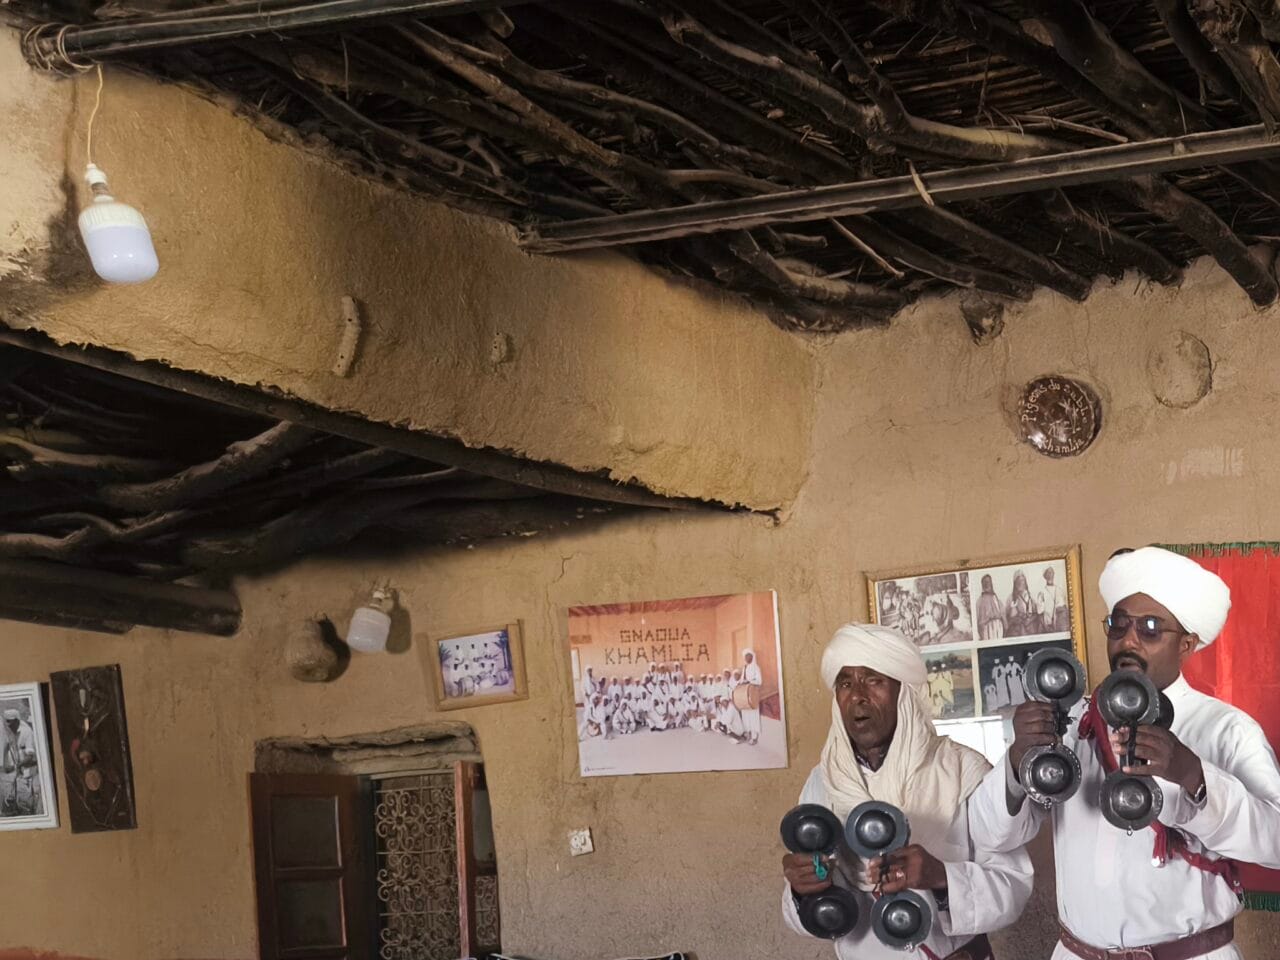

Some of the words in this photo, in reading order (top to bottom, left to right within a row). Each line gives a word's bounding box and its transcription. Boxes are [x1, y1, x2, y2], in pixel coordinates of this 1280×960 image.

[1048, 379, 1061, 391] du
[619, 627, 691, 643] GNAOUA
[604, 642, 710, 665] KHAMLIA
